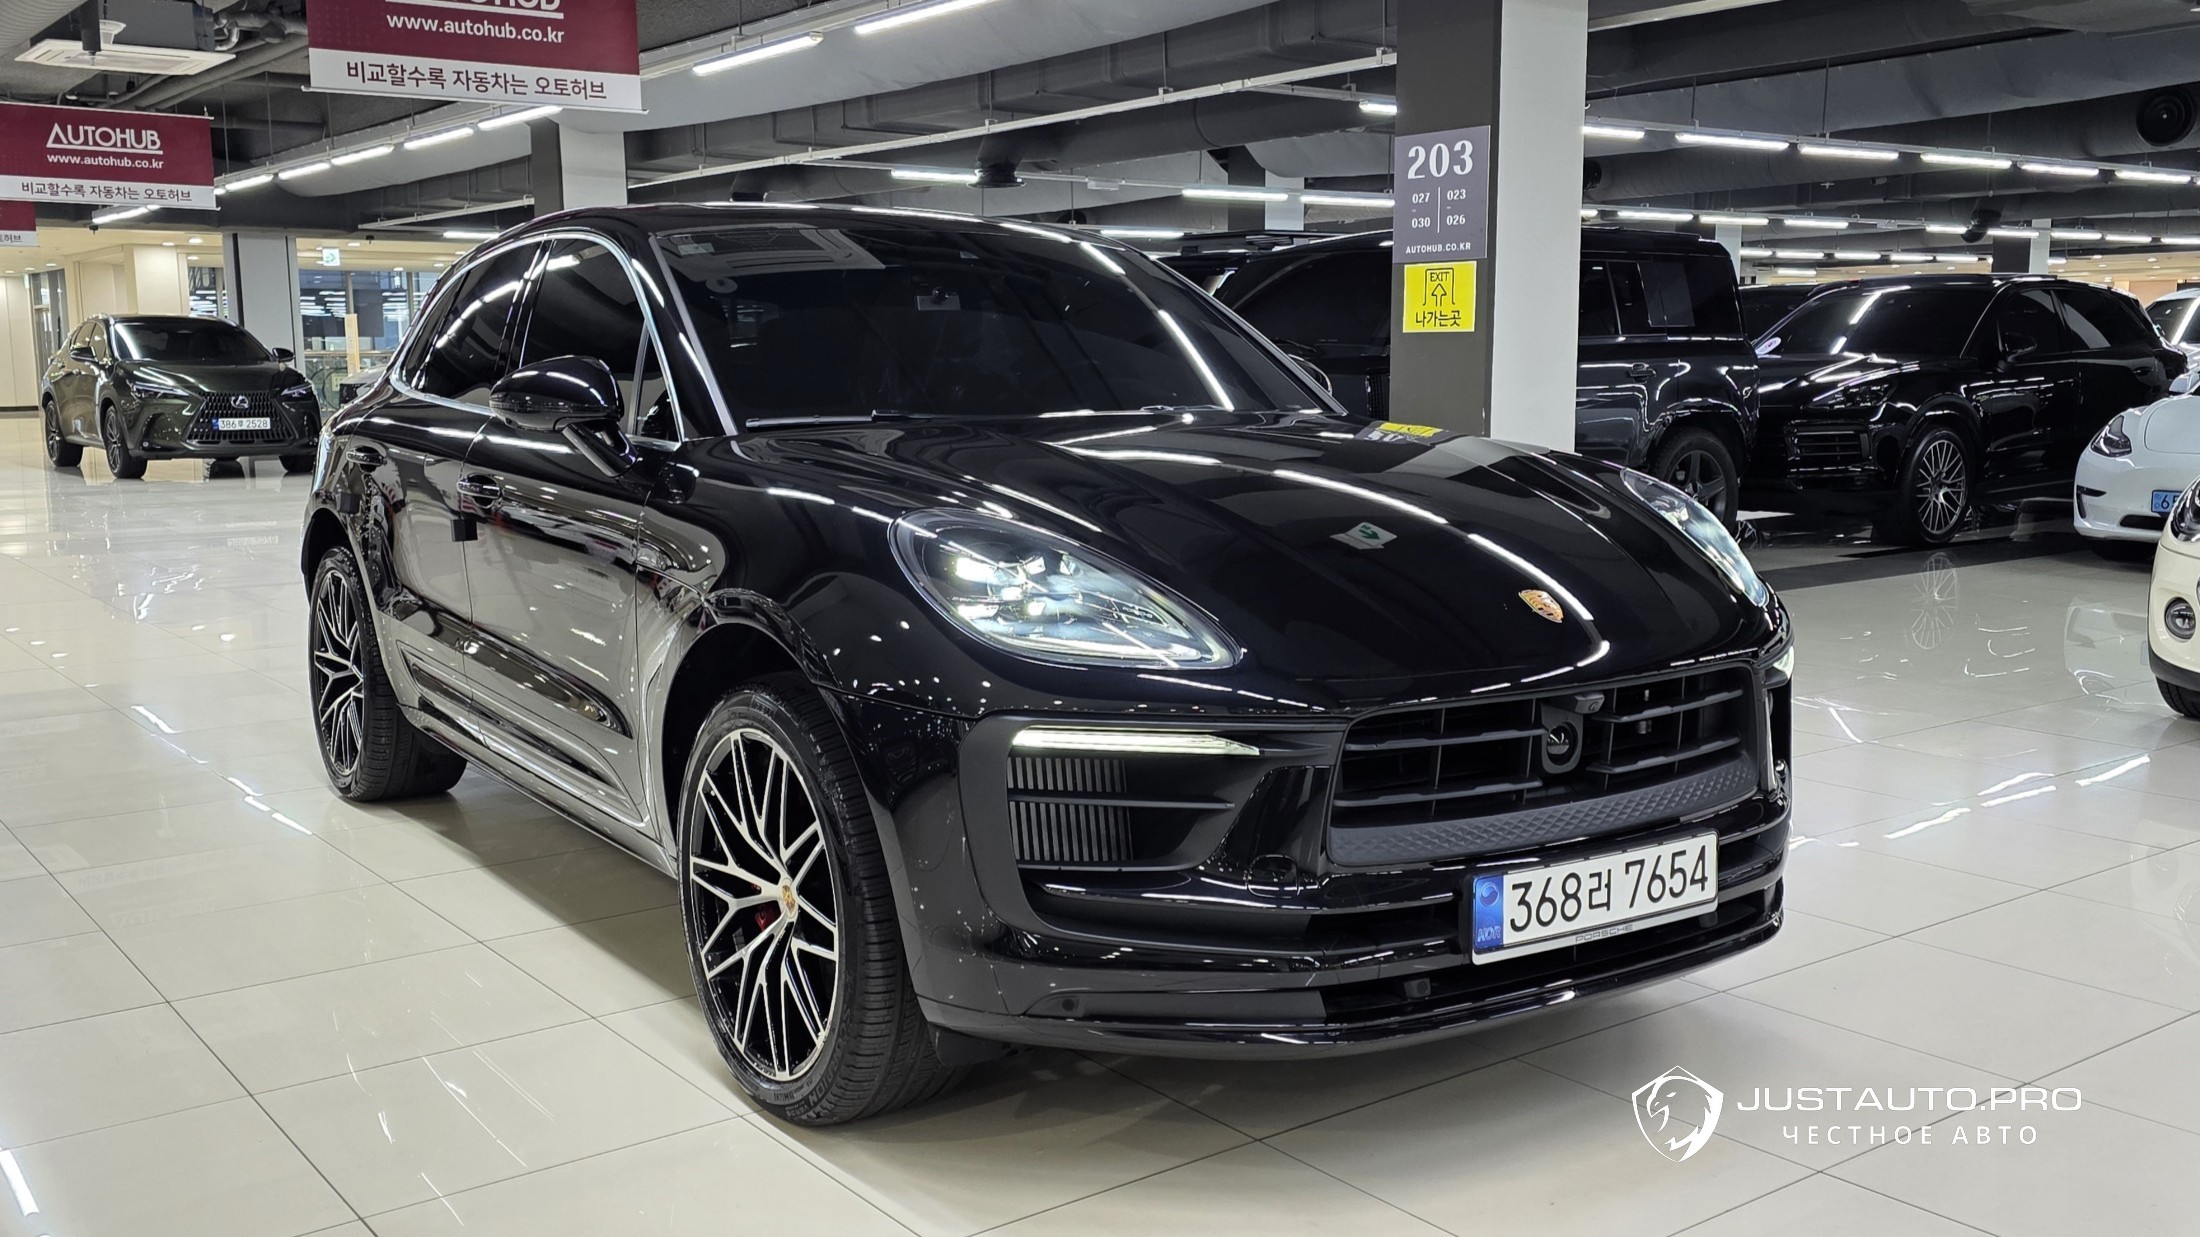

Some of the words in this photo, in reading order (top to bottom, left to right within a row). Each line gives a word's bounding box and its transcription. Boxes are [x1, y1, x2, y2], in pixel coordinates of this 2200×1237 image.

[386, 15, 564, 43] www.autohub.co.kr
[347, 61, 446, 90] 비교할수록
[453, 69, 528, 95] 자동차는
[535, 76, 607, 100] 오토허브
[47, 123, 161, 150] AUTOHUB
[47, 154, 164, 169] www.autohub.co.kr
[1407, 140, 1473, 180] 203
[22, 182, 86, 198] 비교할수록
[90, 185, 139, 200] 자동차는
[144, 188, 192, 202] 오토허브
[1412, 192, 1430, 204] 027
[1447, 189, 1466, 201] 023
[1412, 217, 1431, 228] 030
[1446, 214, 1466, 226] 026
[1405, 242, 1471, 254] AUTOHUB.CO.KR
[1430, 271, 1450, 282] EXIT
[1415, 310, 1461, 328] 나가는곳
[246, 419, 268, 428] 2528
[1510, 869, 1612, 933] 368러
[1625, 845, 1709, 909] 7654
[1575, 924, 1634, 943] PORSCHE
